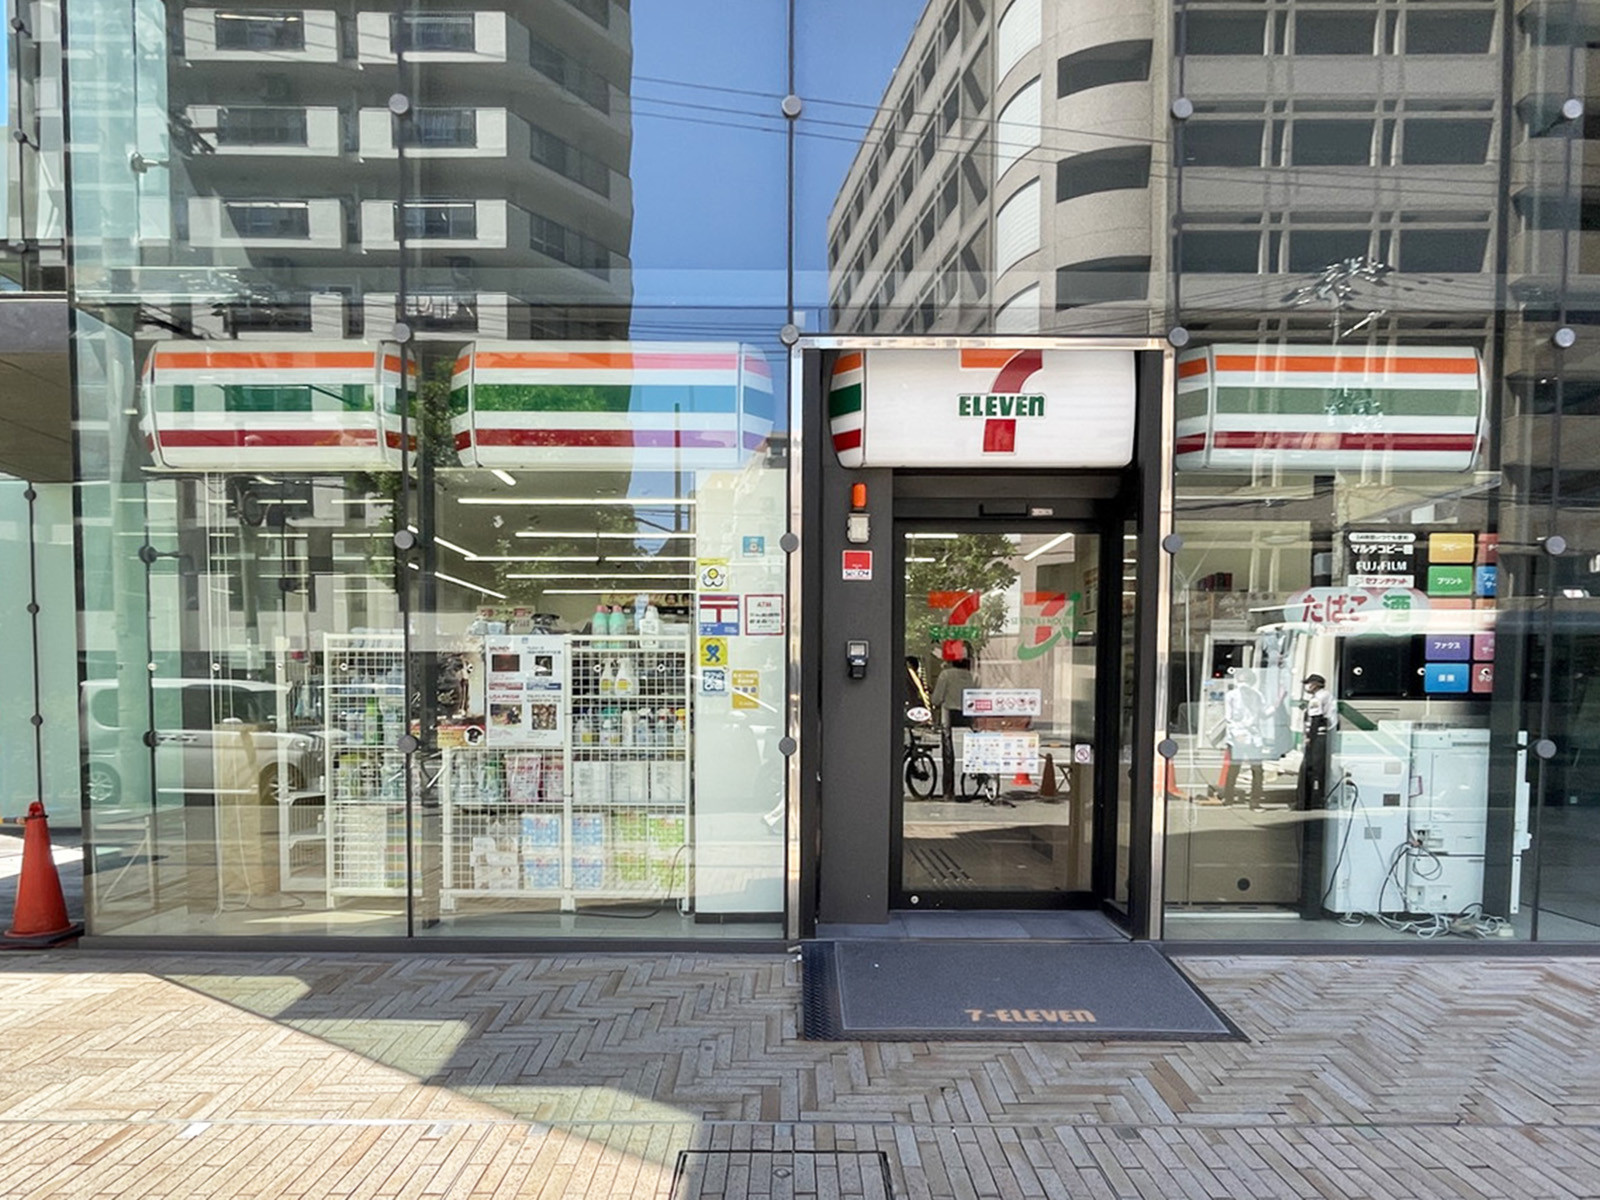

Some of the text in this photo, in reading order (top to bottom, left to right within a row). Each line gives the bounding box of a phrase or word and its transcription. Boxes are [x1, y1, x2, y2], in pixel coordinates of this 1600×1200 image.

[959, 349, 1044, 453] 7
[1350, 544, 1414, 555] マルチコピー機
[1441, 543, 1463, 551] コピー
[1355, 561, 1407, 571] FUJIFILM
[1365, 577, 1407, 585] セブンチケット
[1437, 577, 1463, 585] プリント
[1302, 594, 1412, 623] たばこ 酒
[1434, 641, 1461, 650] ファクス
